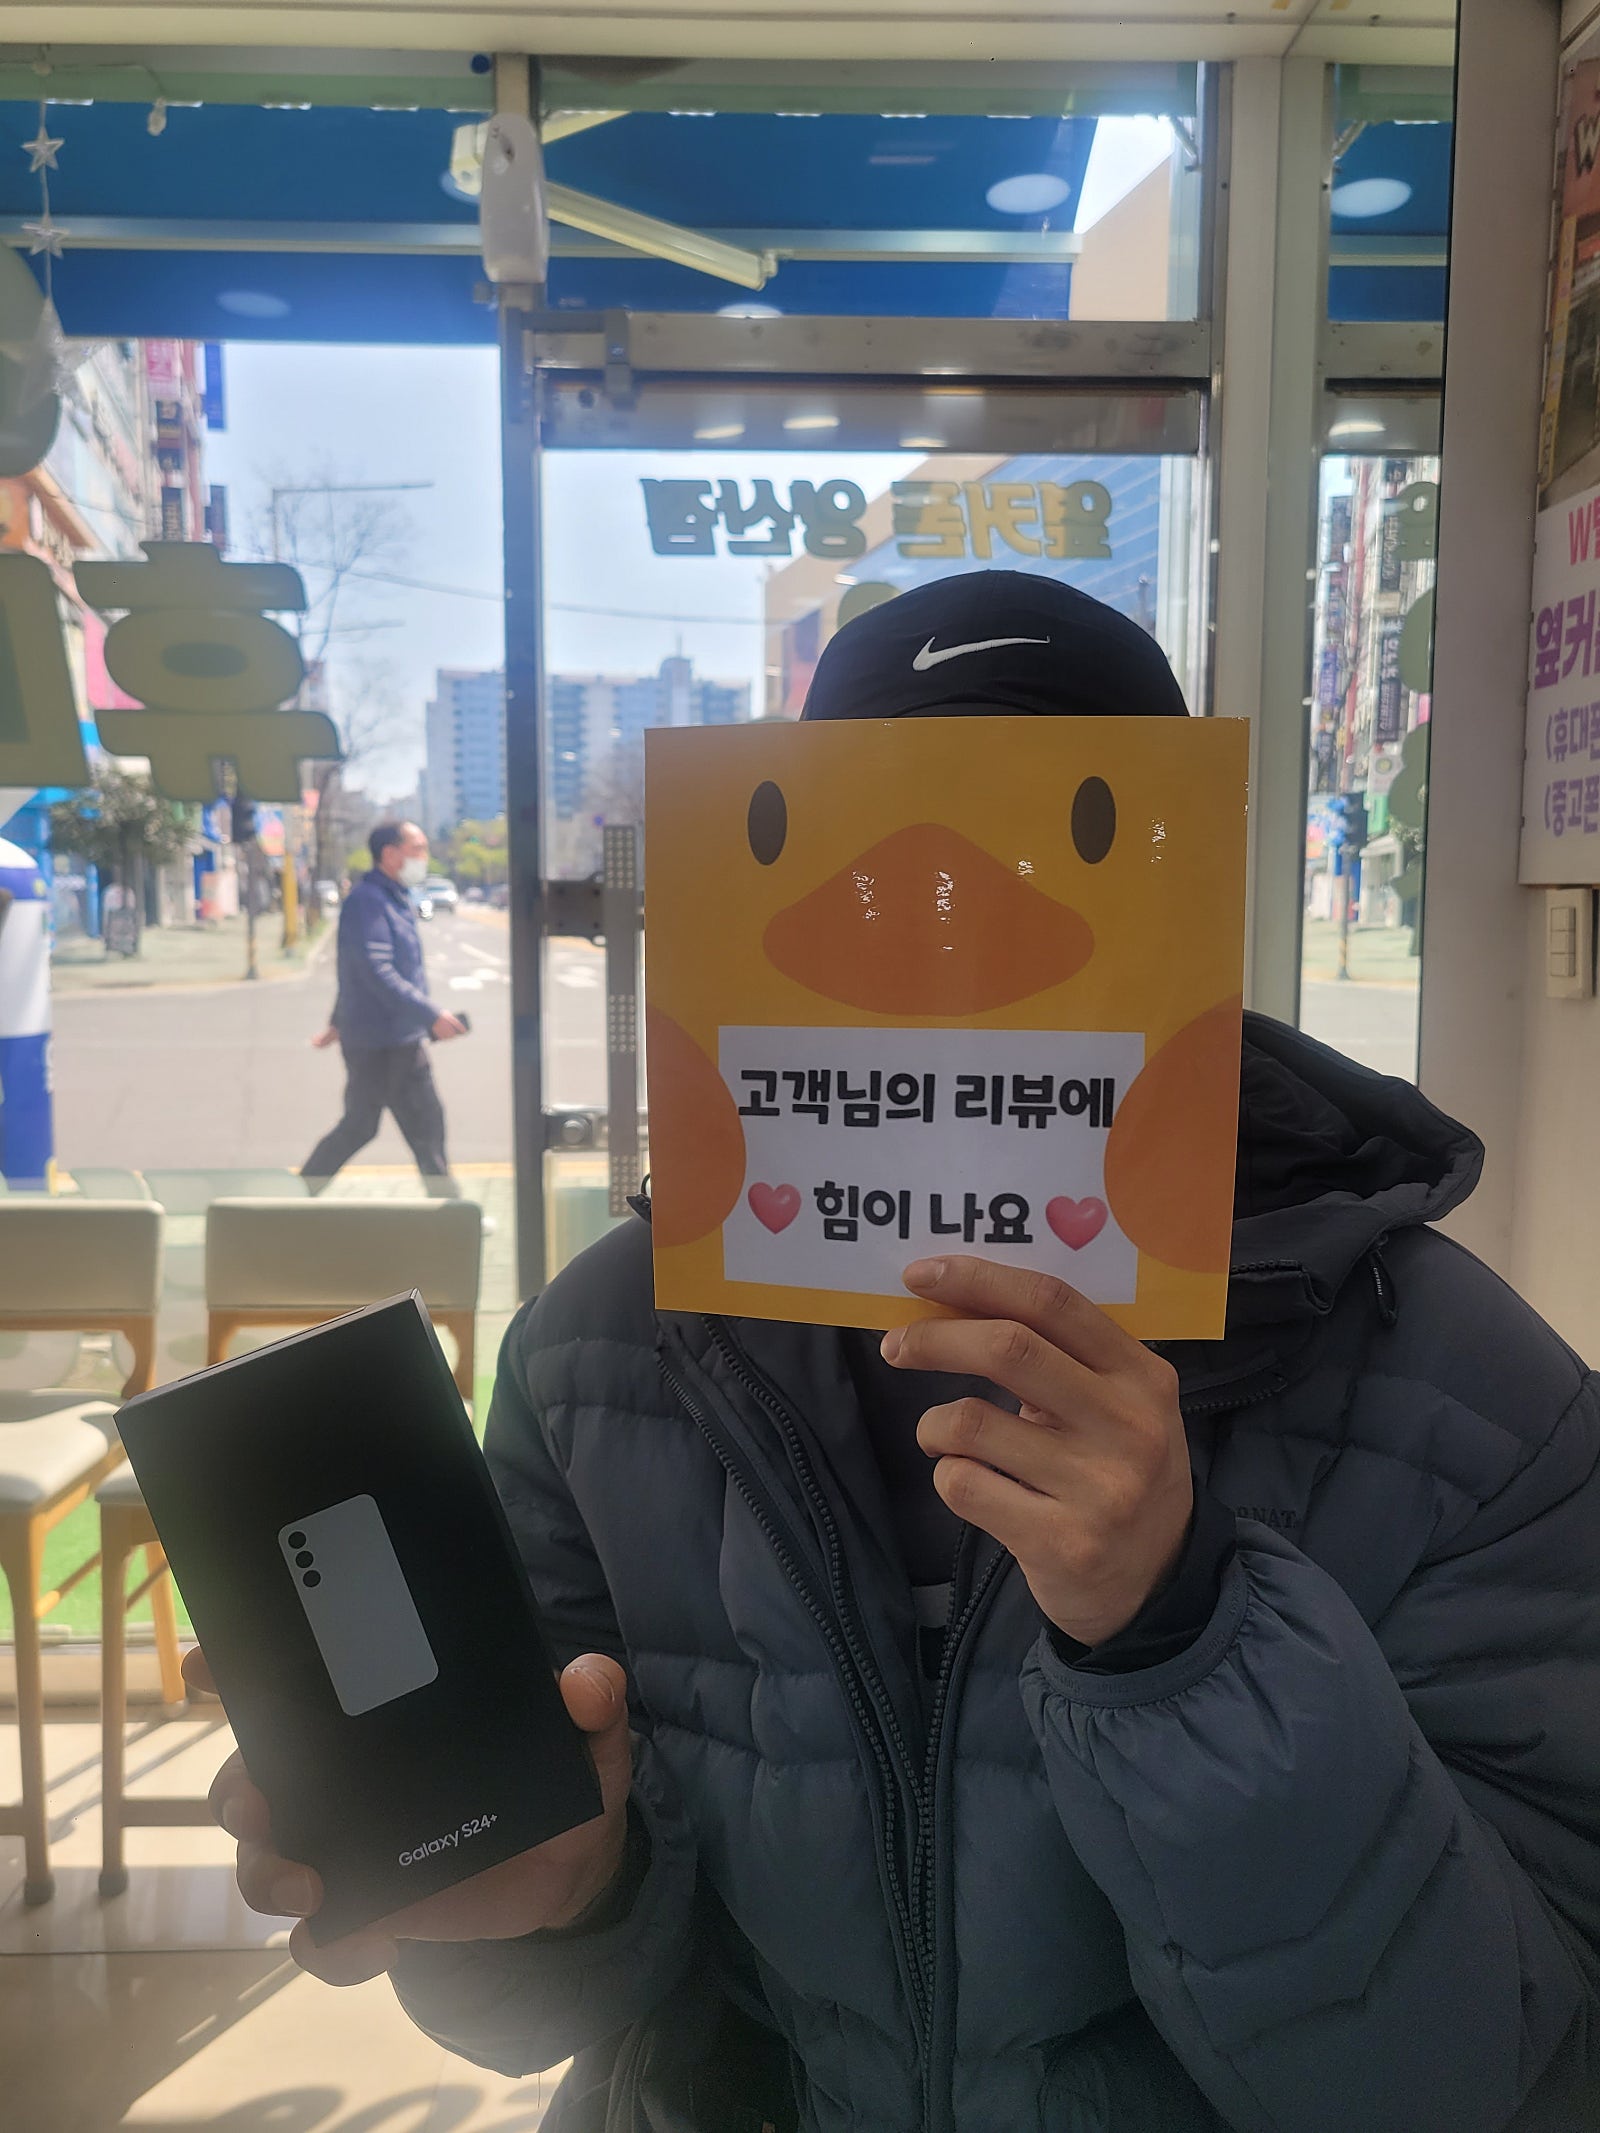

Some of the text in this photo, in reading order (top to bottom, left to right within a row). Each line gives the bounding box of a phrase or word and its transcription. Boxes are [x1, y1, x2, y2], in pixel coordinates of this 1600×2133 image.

[1535, 588, 1600, 691] 옆커
[738, 1069, 1115, 1129] 고객님의 리뷰에
[813, 1180, 1033, 1244] 힘이 나요
[398, 1813, 498, 1867] Galaxy S24+
